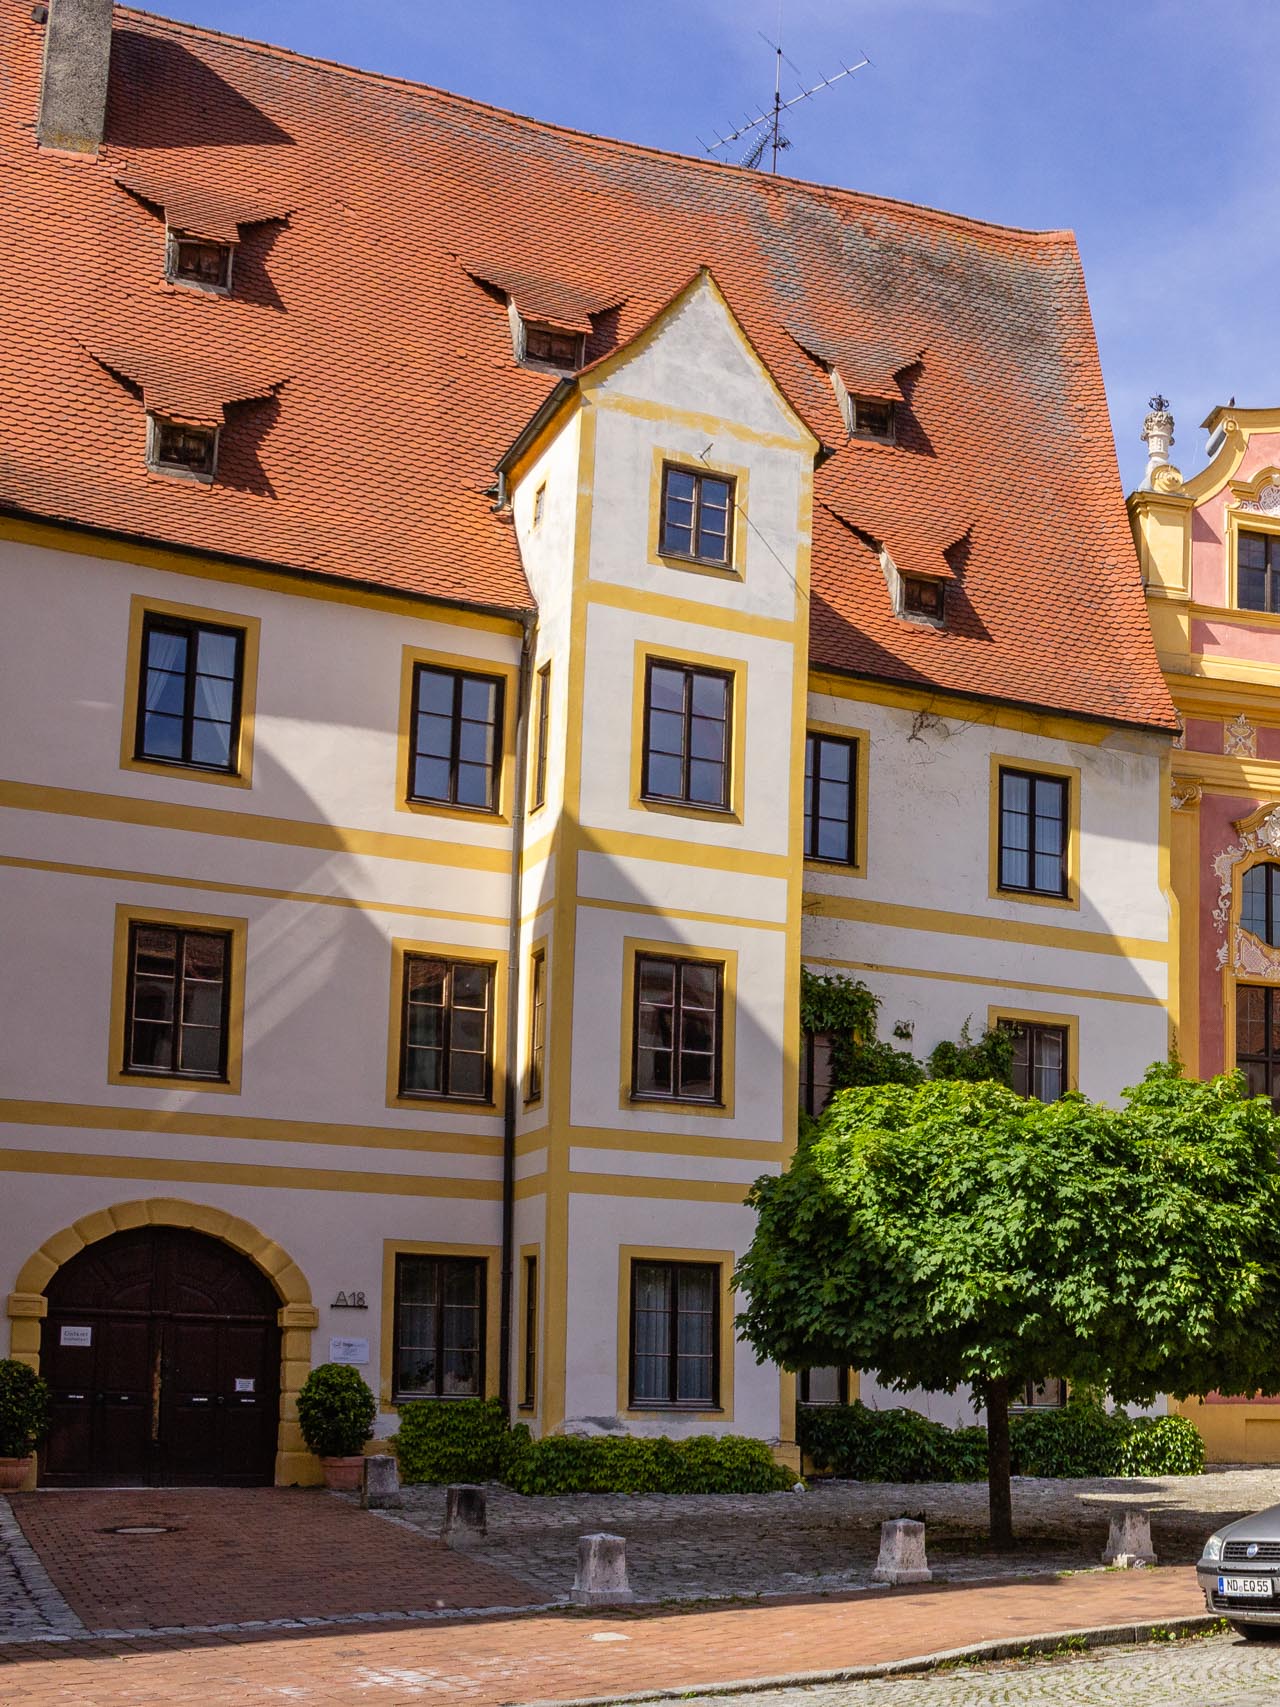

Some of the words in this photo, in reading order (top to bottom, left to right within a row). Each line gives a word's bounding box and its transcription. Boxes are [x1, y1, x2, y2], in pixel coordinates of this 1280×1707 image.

[336, 1290, 366, 1306] A18
[1227, 1579, 1239, 1592] ND
[1243, 1580, 1256, 1592] EQ
[1257, 1580, 1269, 1593] 55
